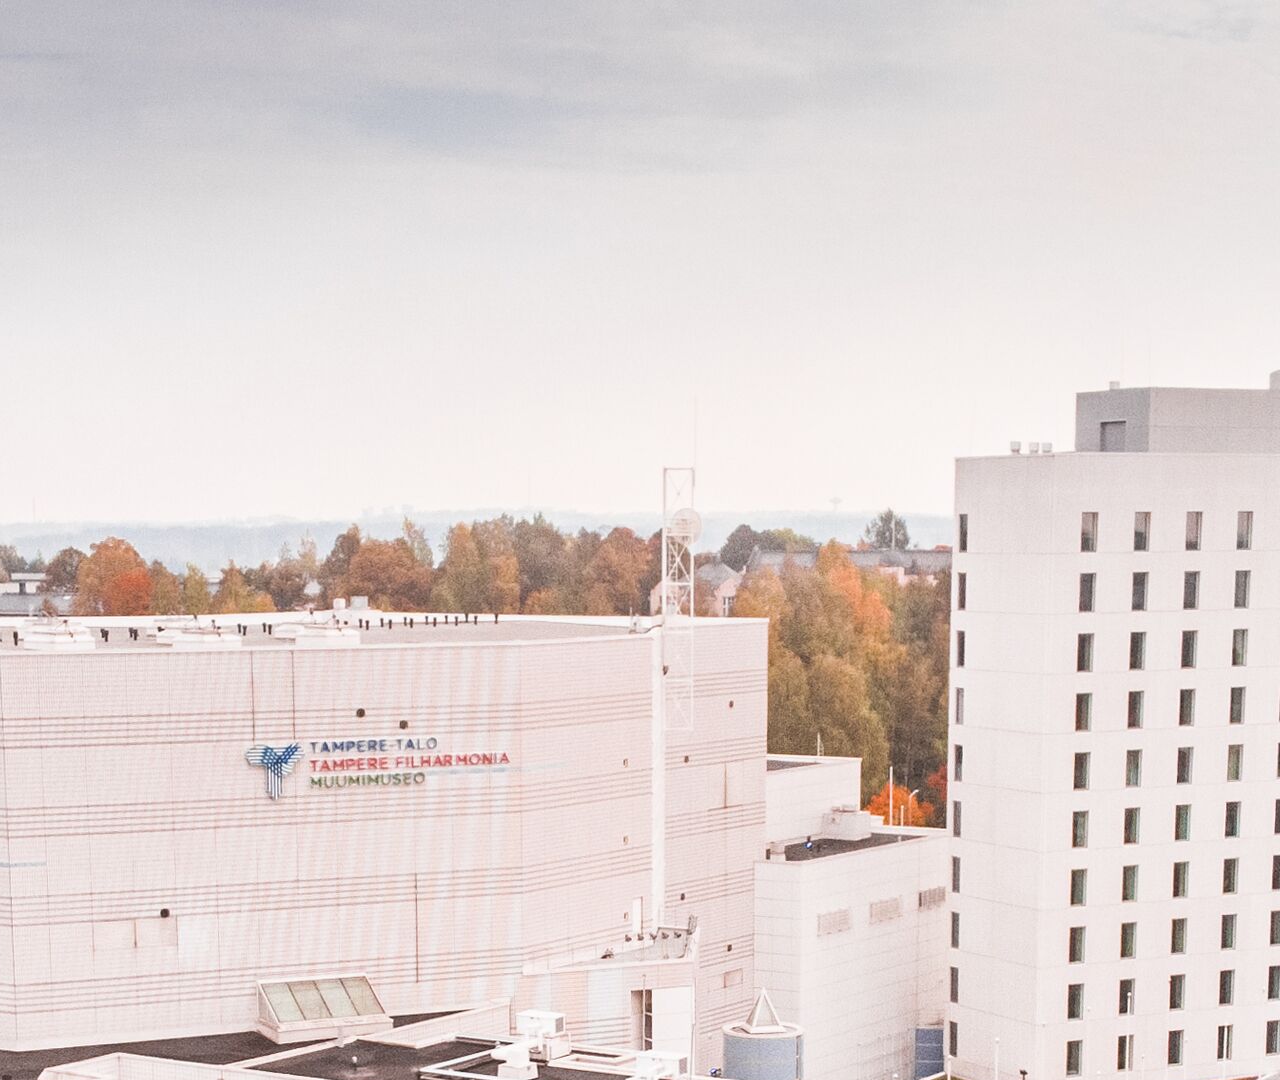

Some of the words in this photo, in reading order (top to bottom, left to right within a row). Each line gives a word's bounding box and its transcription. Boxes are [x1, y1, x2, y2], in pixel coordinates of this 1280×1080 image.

[310, 737, 438, 753] TAMPERE-TALO
[310, 757, 389, 772] TAMPERE
[396, 752, 510, 768] FILHARMONIA
[309, 772, 425, 788] MUUMIMUSEO
